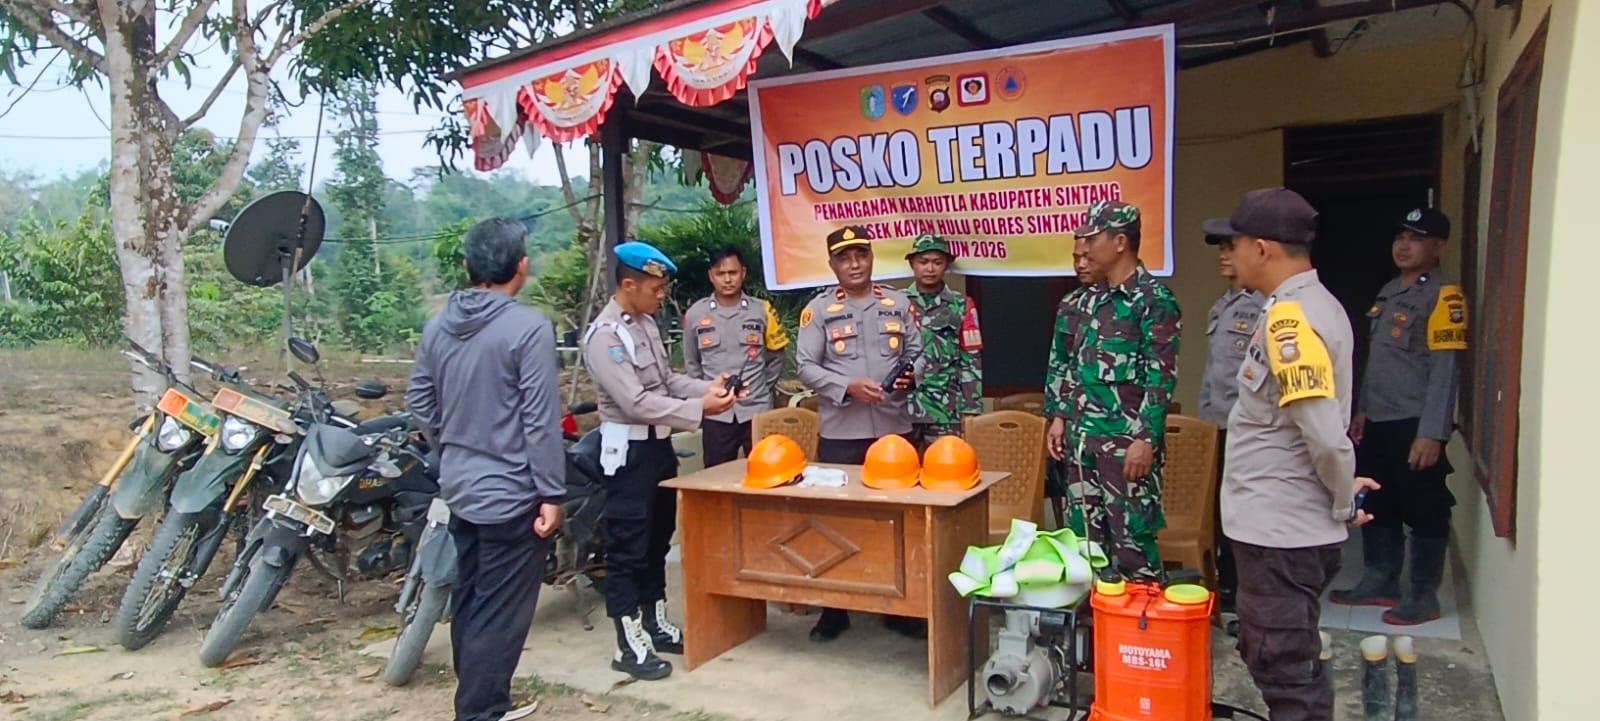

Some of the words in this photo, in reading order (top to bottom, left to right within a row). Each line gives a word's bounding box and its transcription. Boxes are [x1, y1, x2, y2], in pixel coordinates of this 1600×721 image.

[777, 130, 921, 195] POSKO
[927, 105, 1152, 183] TERPADU
[814, 197, 898, 220] PENANGANAN
[899, 194, 967, 213] KARHUTLA
[970, 188, 1051, 211] KABUPATEN
[1056, 183, 1120, 206] SINTANG
[894, 219, 934, 239] KAYAN
[937, 217, 971, 236] HULU
[973, 215, 1024, 236] POLRES
[971, 240, 1007, 258] 2026
[1118, 643, 1172, 660] MOTOYAMA
